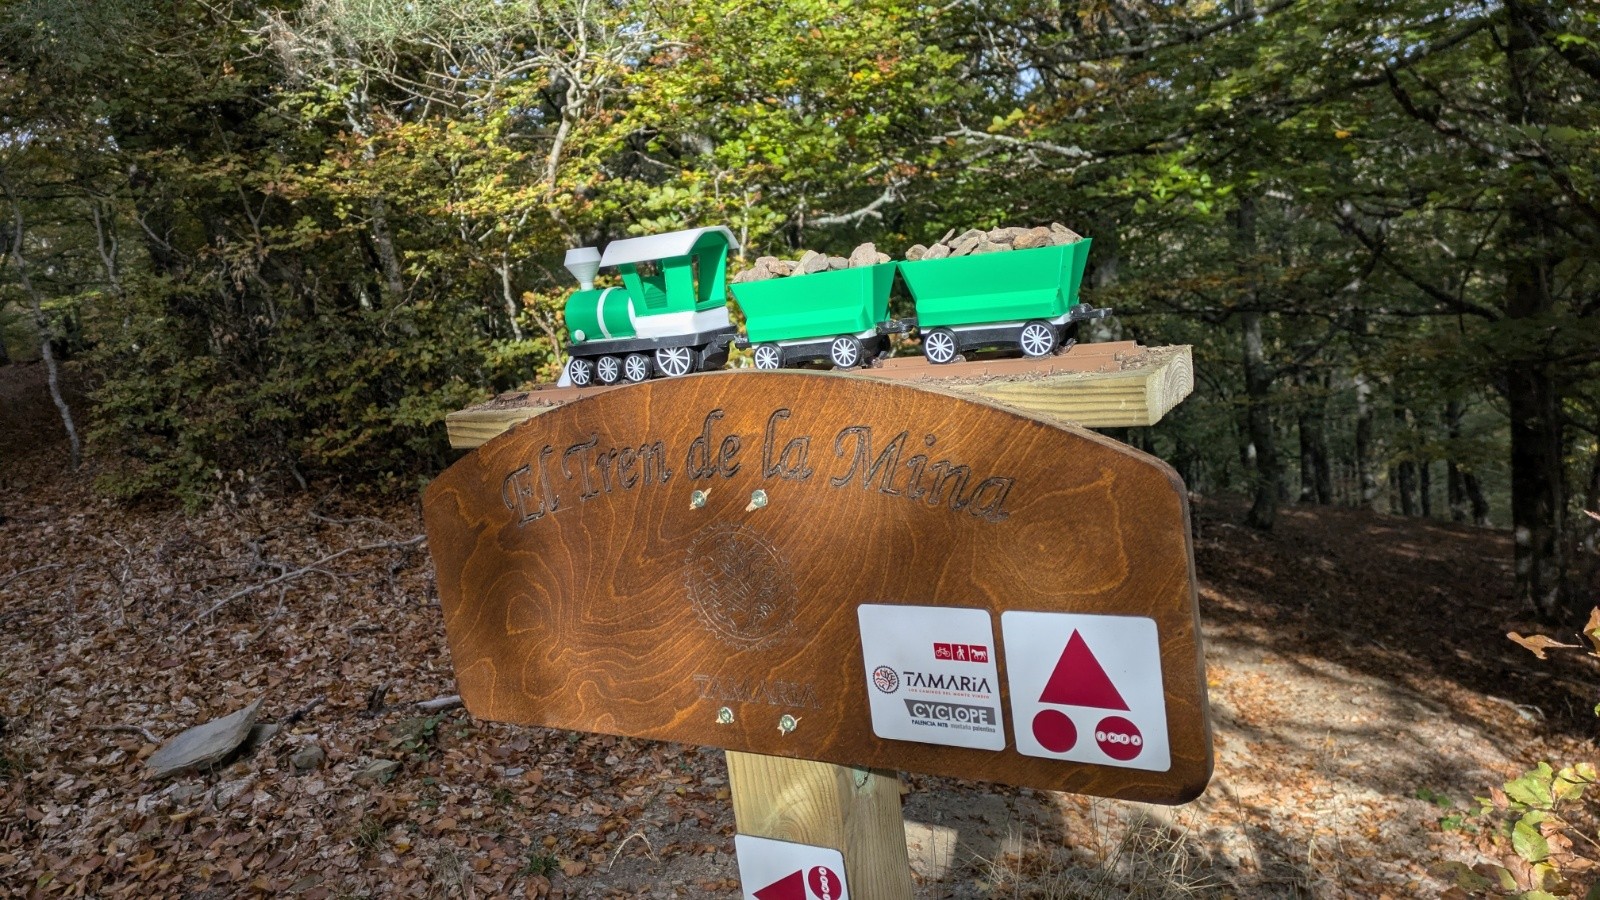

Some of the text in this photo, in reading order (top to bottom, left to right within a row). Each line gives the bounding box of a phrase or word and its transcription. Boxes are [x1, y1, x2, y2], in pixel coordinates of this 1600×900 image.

[502, 408, 1016, 528] El Tren de la Mina
[911, 719, 936, 727] PALENCIA
[912, 702, 988, 725] CYCLOPE
